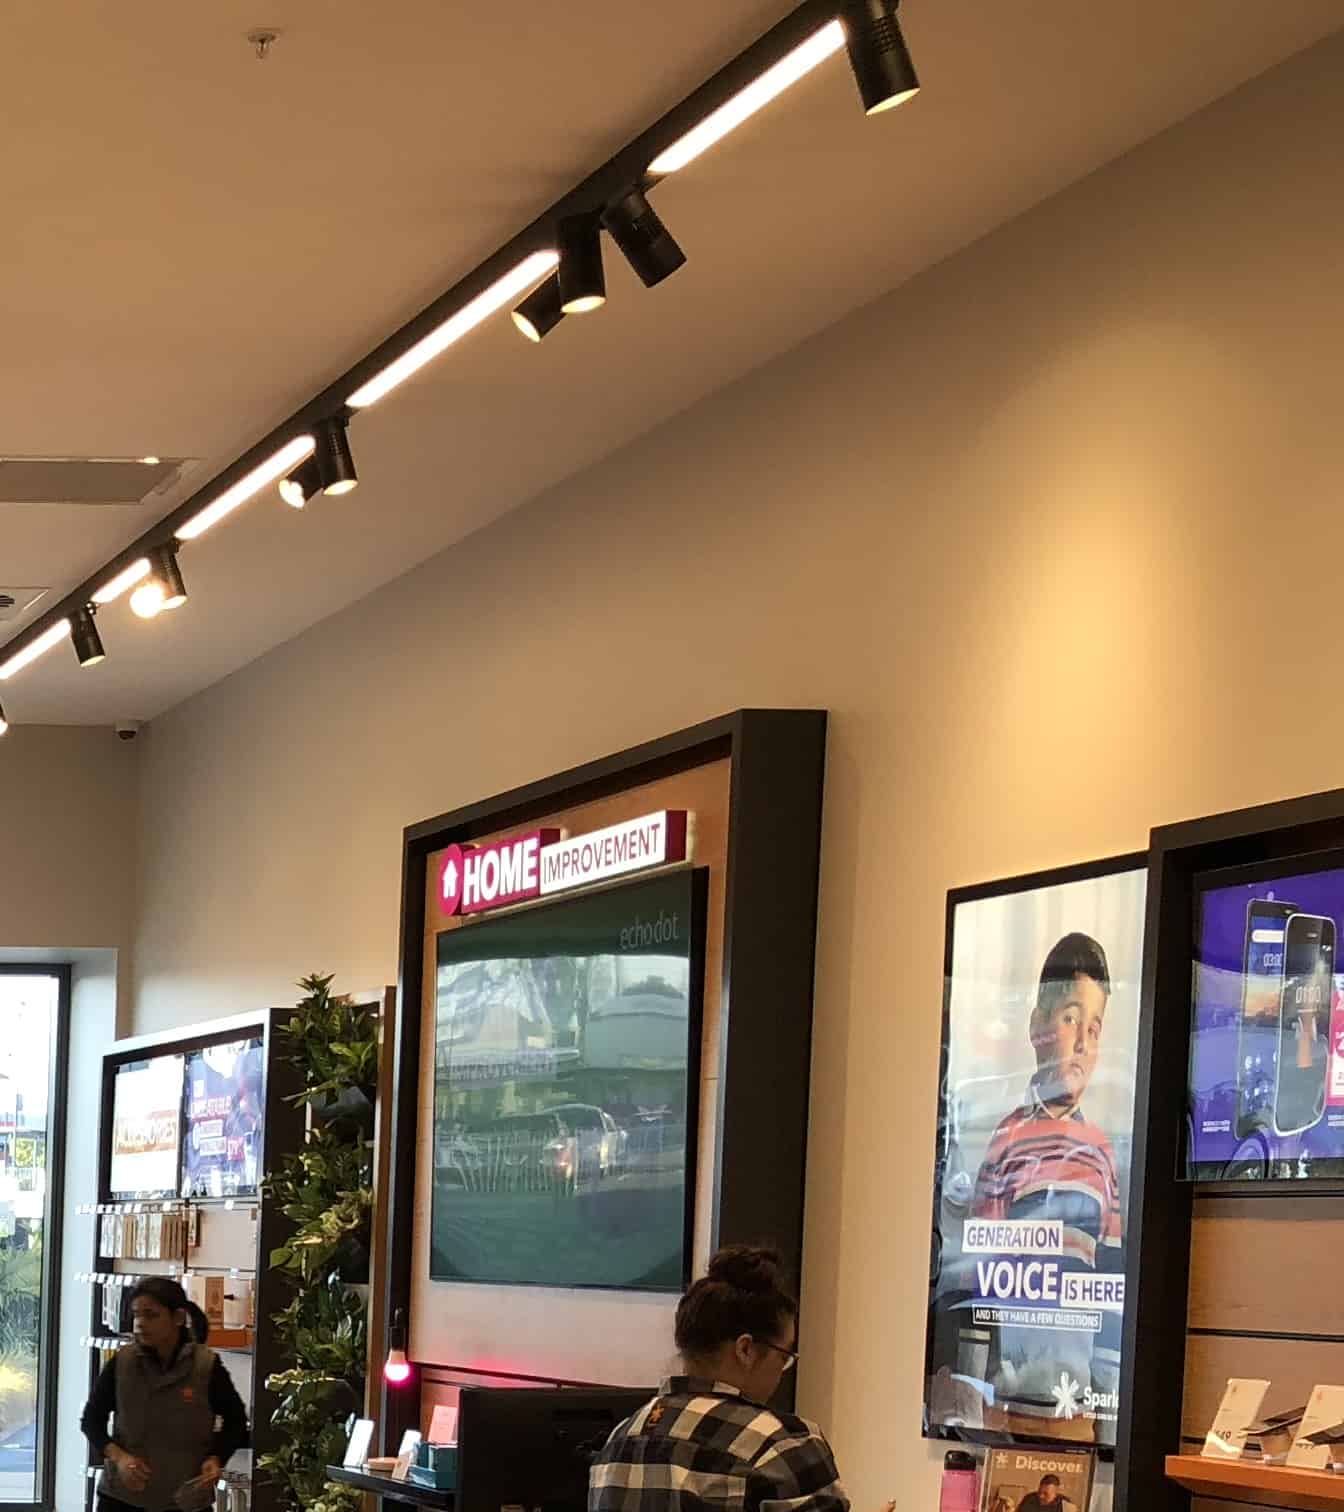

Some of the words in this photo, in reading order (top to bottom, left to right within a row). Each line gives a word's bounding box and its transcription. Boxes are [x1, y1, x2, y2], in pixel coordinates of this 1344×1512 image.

[463, 836, 539, 907] HOME
[543, 823, 661, 885] IMPROVEMENT
[620, 912, 653, 950] echo
[654, 909, 680, 943] dot
[967, 1225, 1060, 1249] GENERATION
[976, 1260, 1059, 1301] VOICE
[1064, 1279, 1078, 1301] IS
[1081, 1280, 1124, 1303] HERE
[975, 1309, 991, 1321] AND
